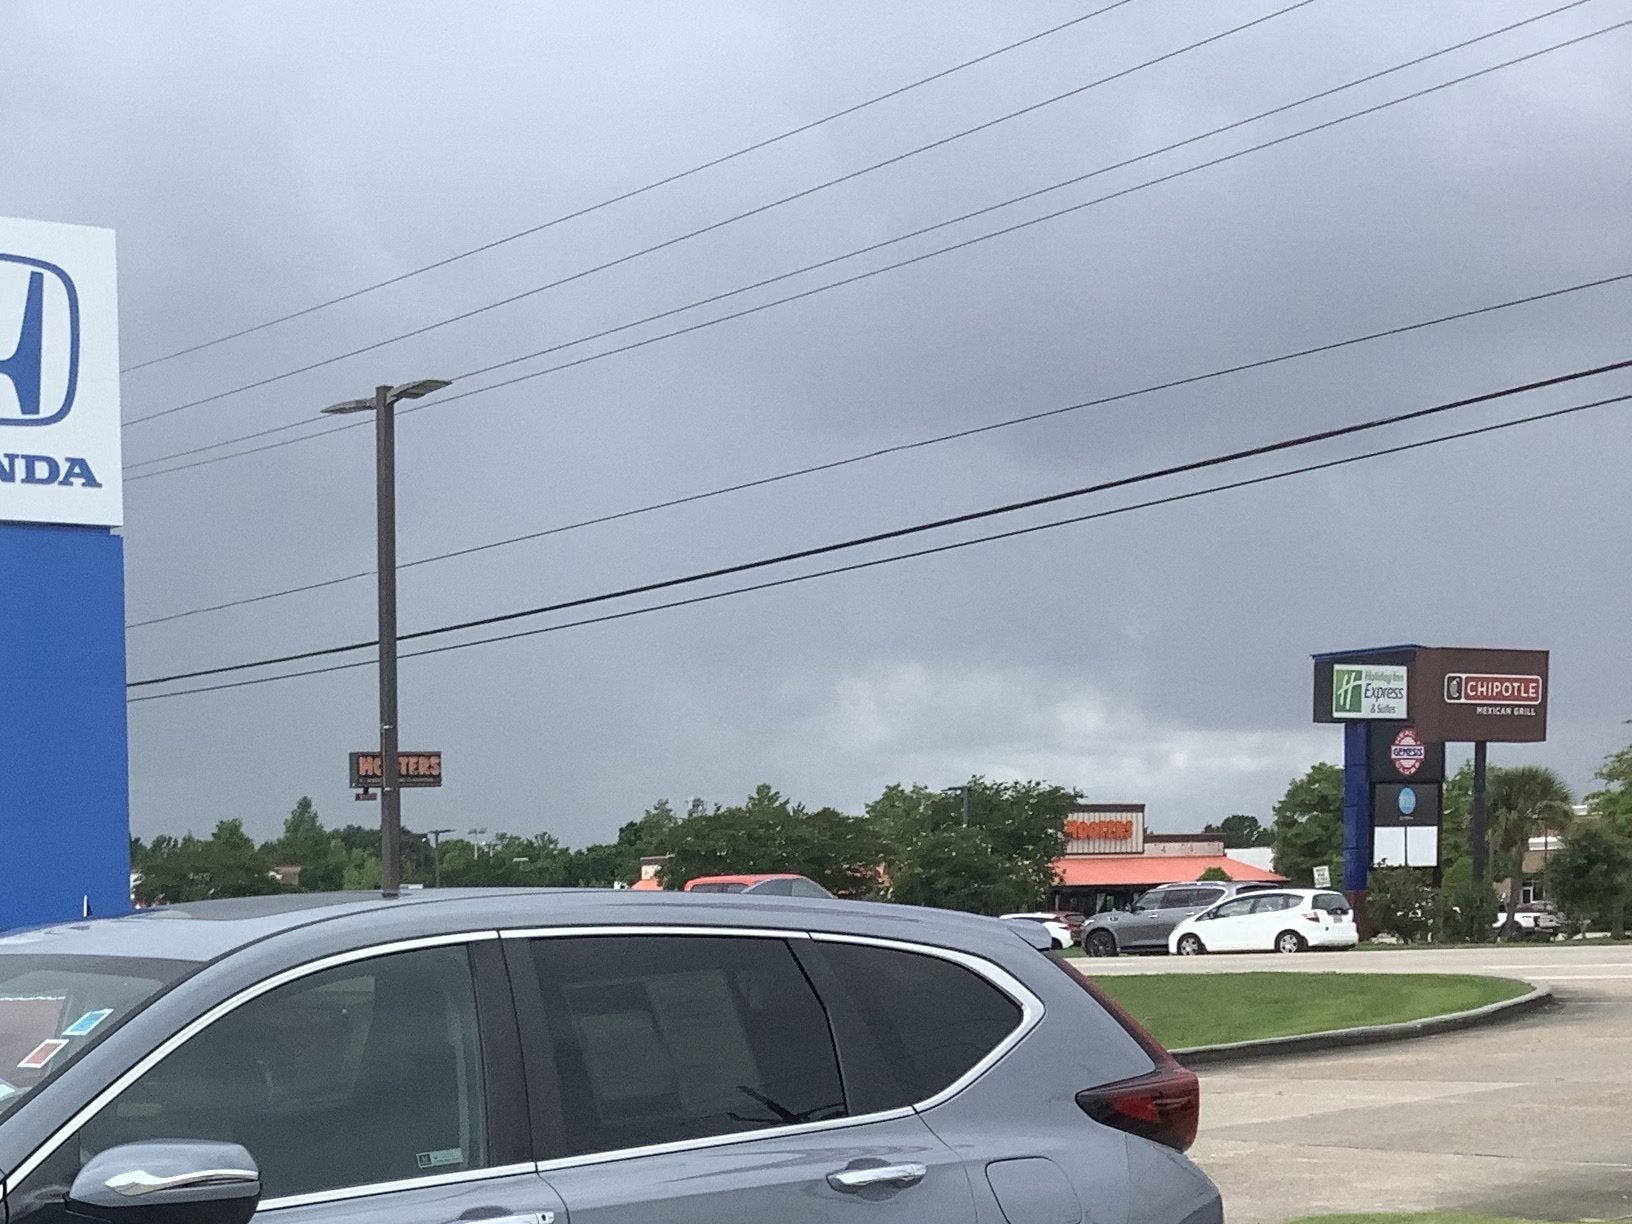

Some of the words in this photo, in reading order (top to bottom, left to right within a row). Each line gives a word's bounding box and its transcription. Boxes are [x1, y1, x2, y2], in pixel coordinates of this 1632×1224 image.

[1364, 682, 1404, 702] Express
[1466, 680, 1538, 698] CHIPOTLE
[1475, 706, 1512, 716] MEXICAN
[1513, 707, 1536, 716] GRILL
[1392, 747, 1424, 757] GENESIS
[359, 757, 440, 775] HOTERS
